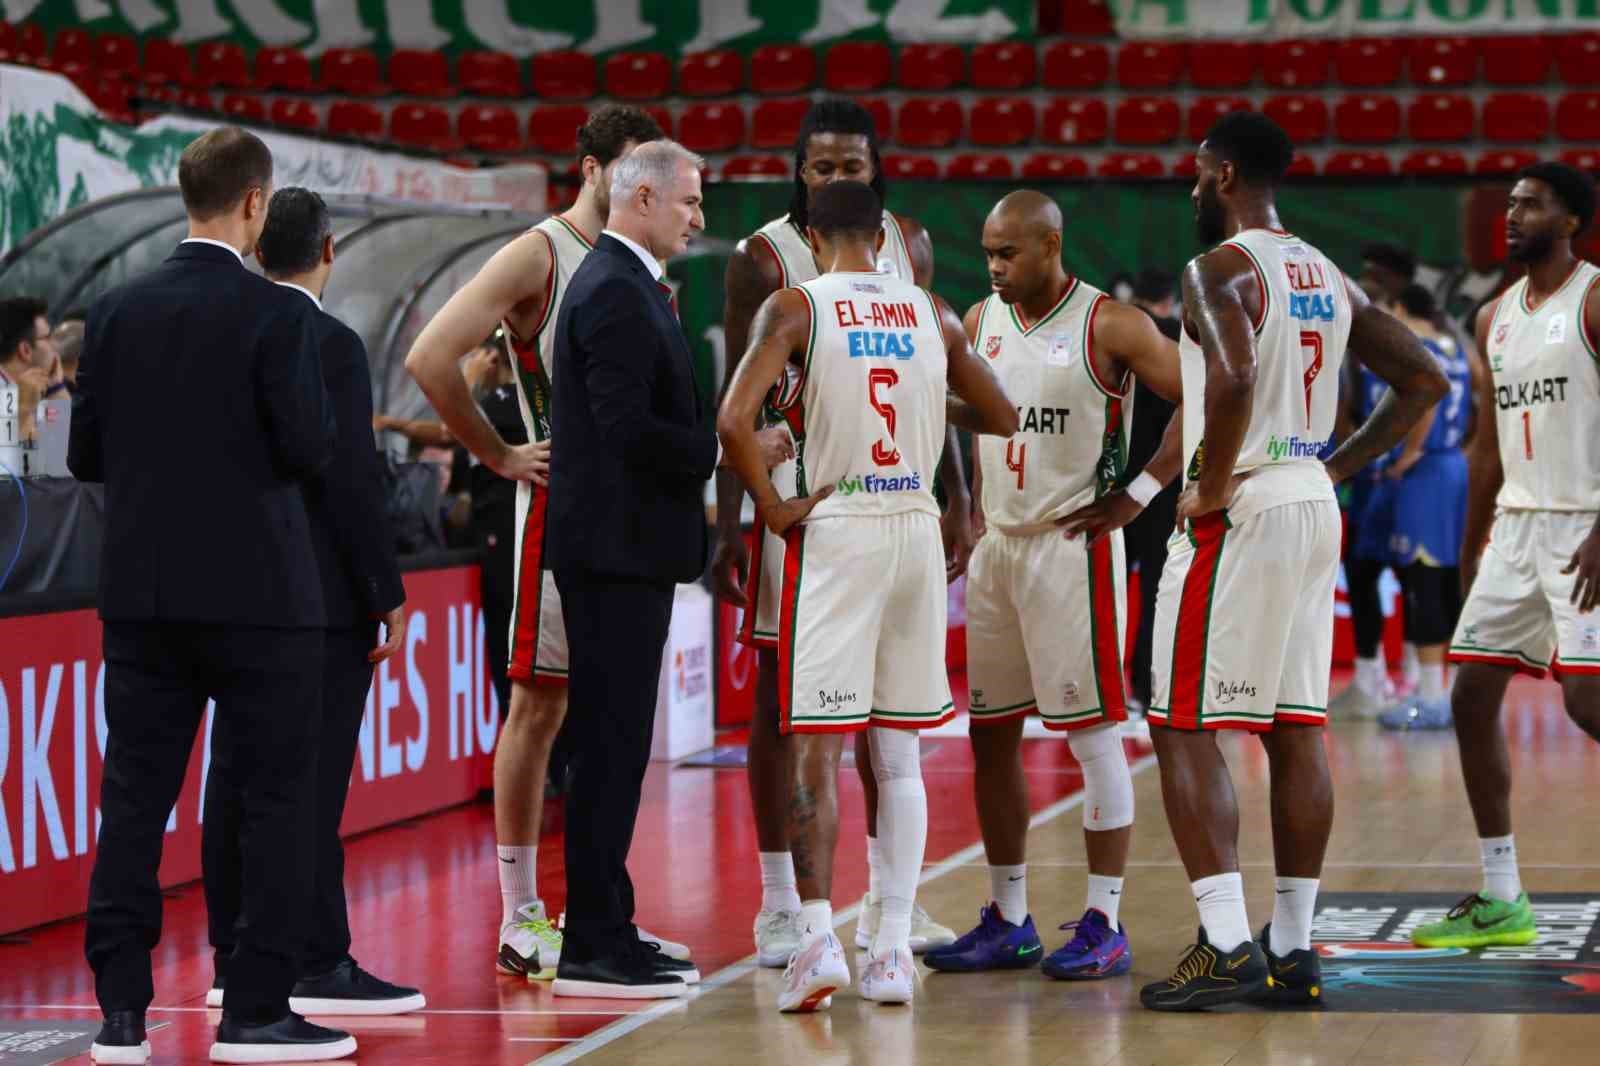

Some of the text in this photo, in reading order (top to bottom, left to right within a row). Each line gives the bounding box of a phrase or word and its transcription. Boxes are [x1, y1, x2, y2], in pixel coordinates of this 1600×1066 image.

[834, 299, 918, 328] EL-AMIN
[1300, 331, 1323, 430] 7
[1494, 376, 1568, 410] OLKART
[869, 368, 901, 466] 5
[1016, 406, 1070, 434] ART
[1522, 411, 1533, 460] 1
[1006, 438, 1026, 490] 4
